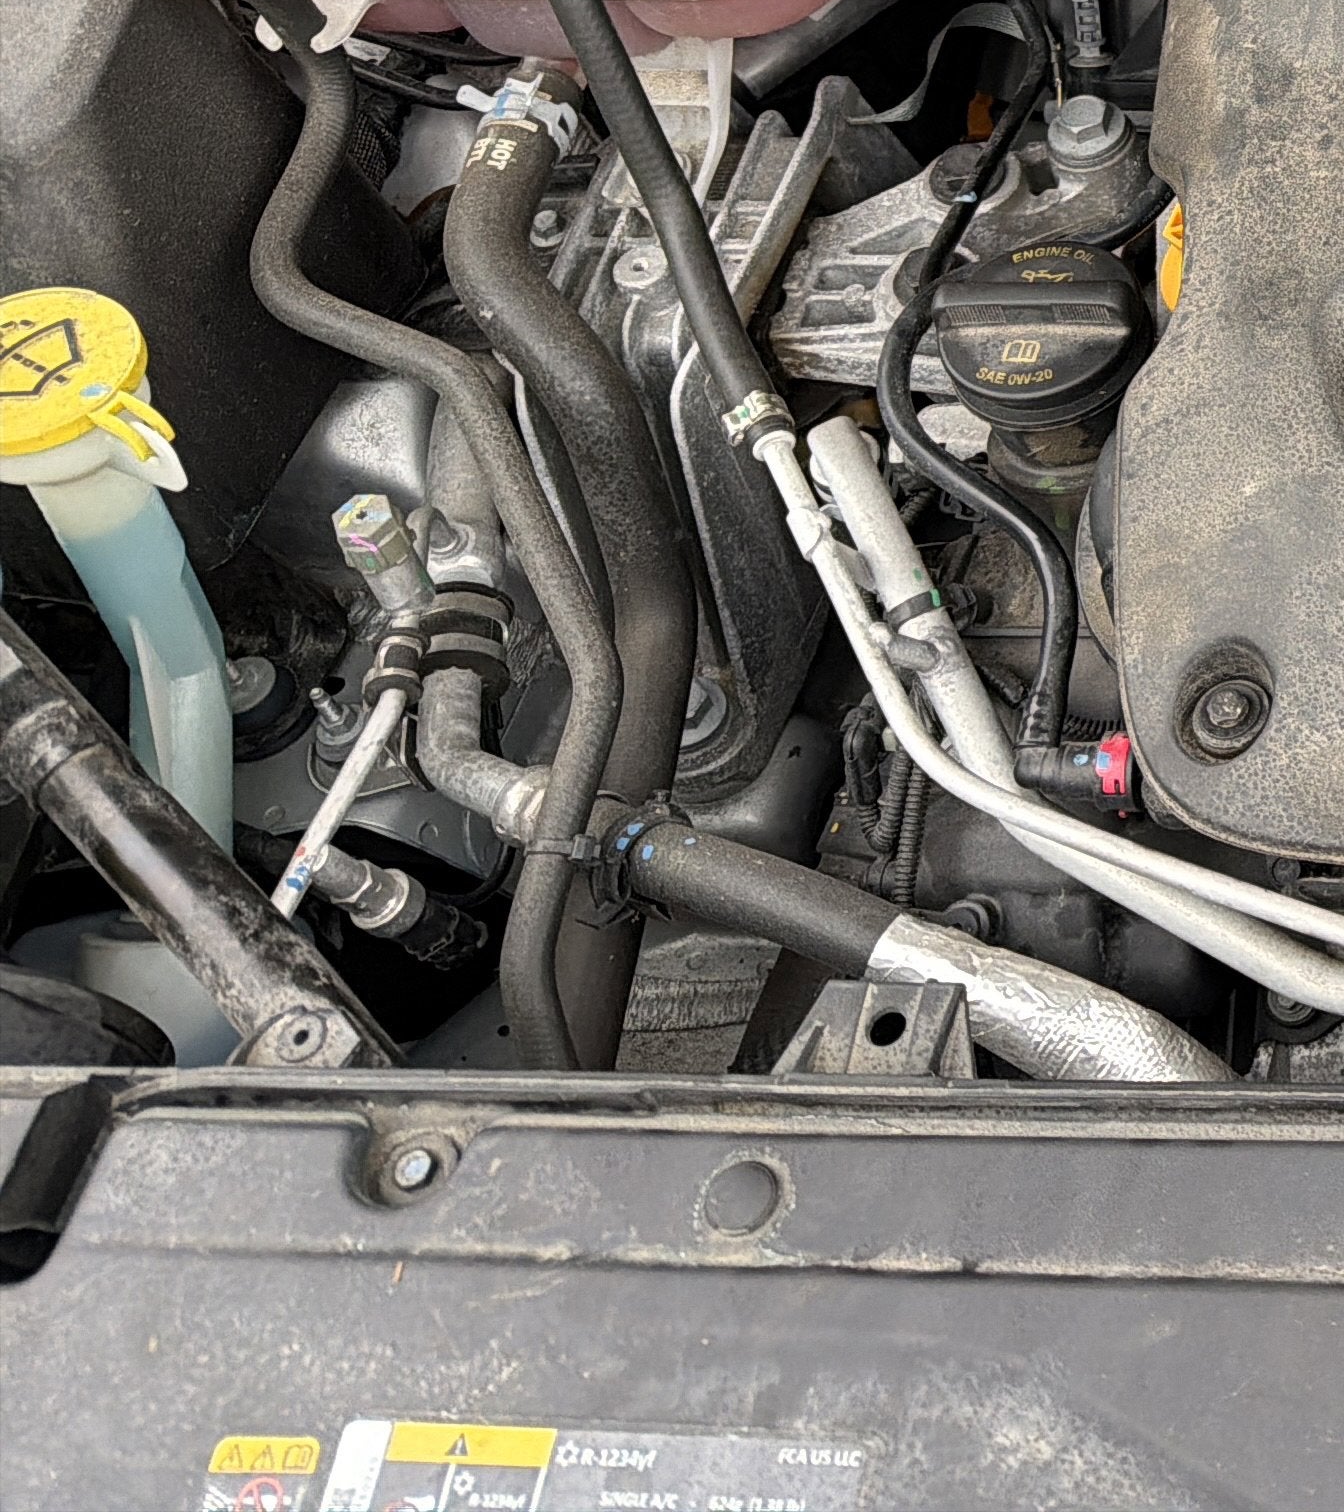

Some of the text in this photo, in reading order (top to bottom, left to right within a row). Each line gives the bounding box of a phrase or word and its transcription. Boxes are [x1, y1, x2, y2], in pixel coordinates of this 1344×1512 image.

[487, 138, 518, 170] HOT
[1012, 246, 1095, 265] ENGINE OIL
[976, 367, 1053, 385] SAE 0W-20
[778, 1447, 864, 1467] FCA US LLC
